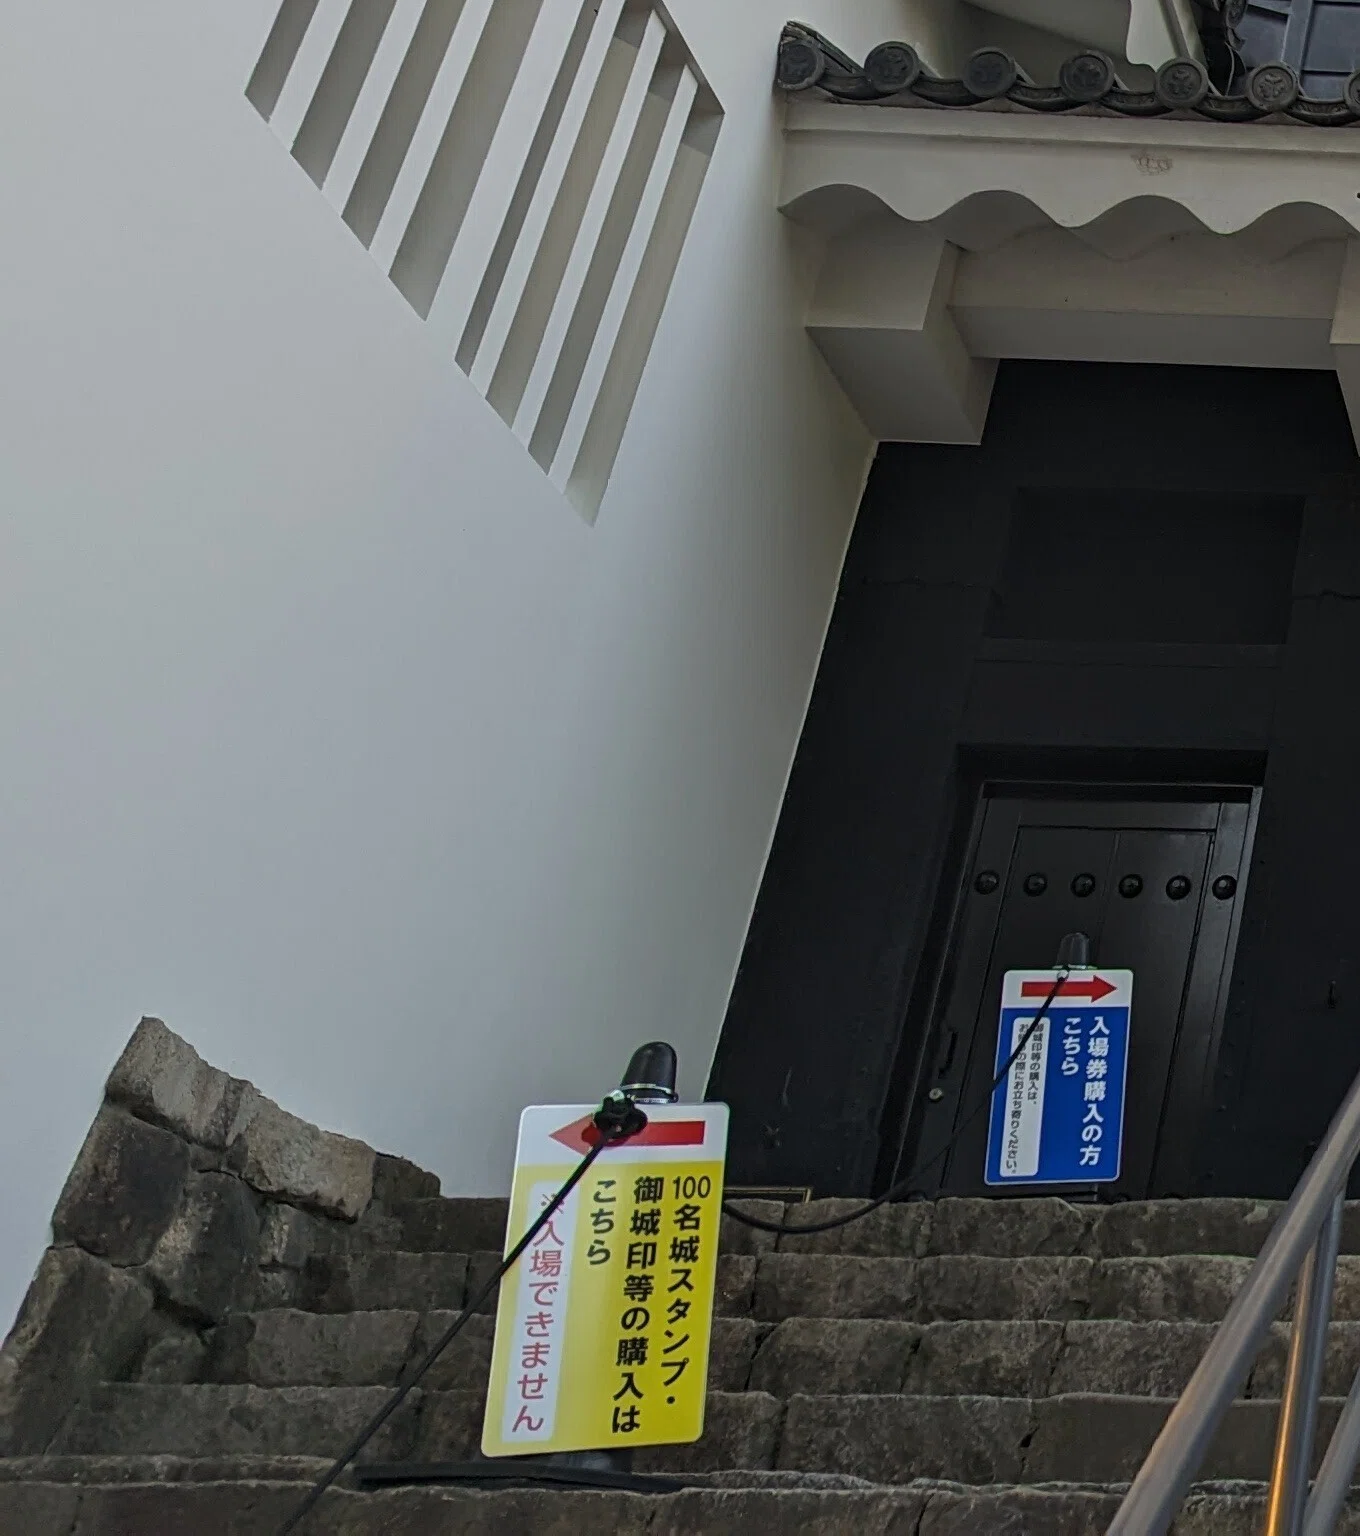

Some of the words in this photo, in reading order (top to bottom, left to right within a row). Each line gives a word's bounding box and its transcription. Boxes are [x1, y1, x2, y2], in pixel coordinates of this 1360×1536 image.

[1006, 1023, 1028, 1174] おの際にお立ち寄りください。
[1061, 1016, 1082, 1076] こちら
[1079, 1015, 1111, 1167] 入場券購入の方
[586, 1178, 617, 1266] こちら
[660, 1175, 712, 1406] 100名城スタンプ・
[611, 1175, 664, 1435] 御城印等の購入は
